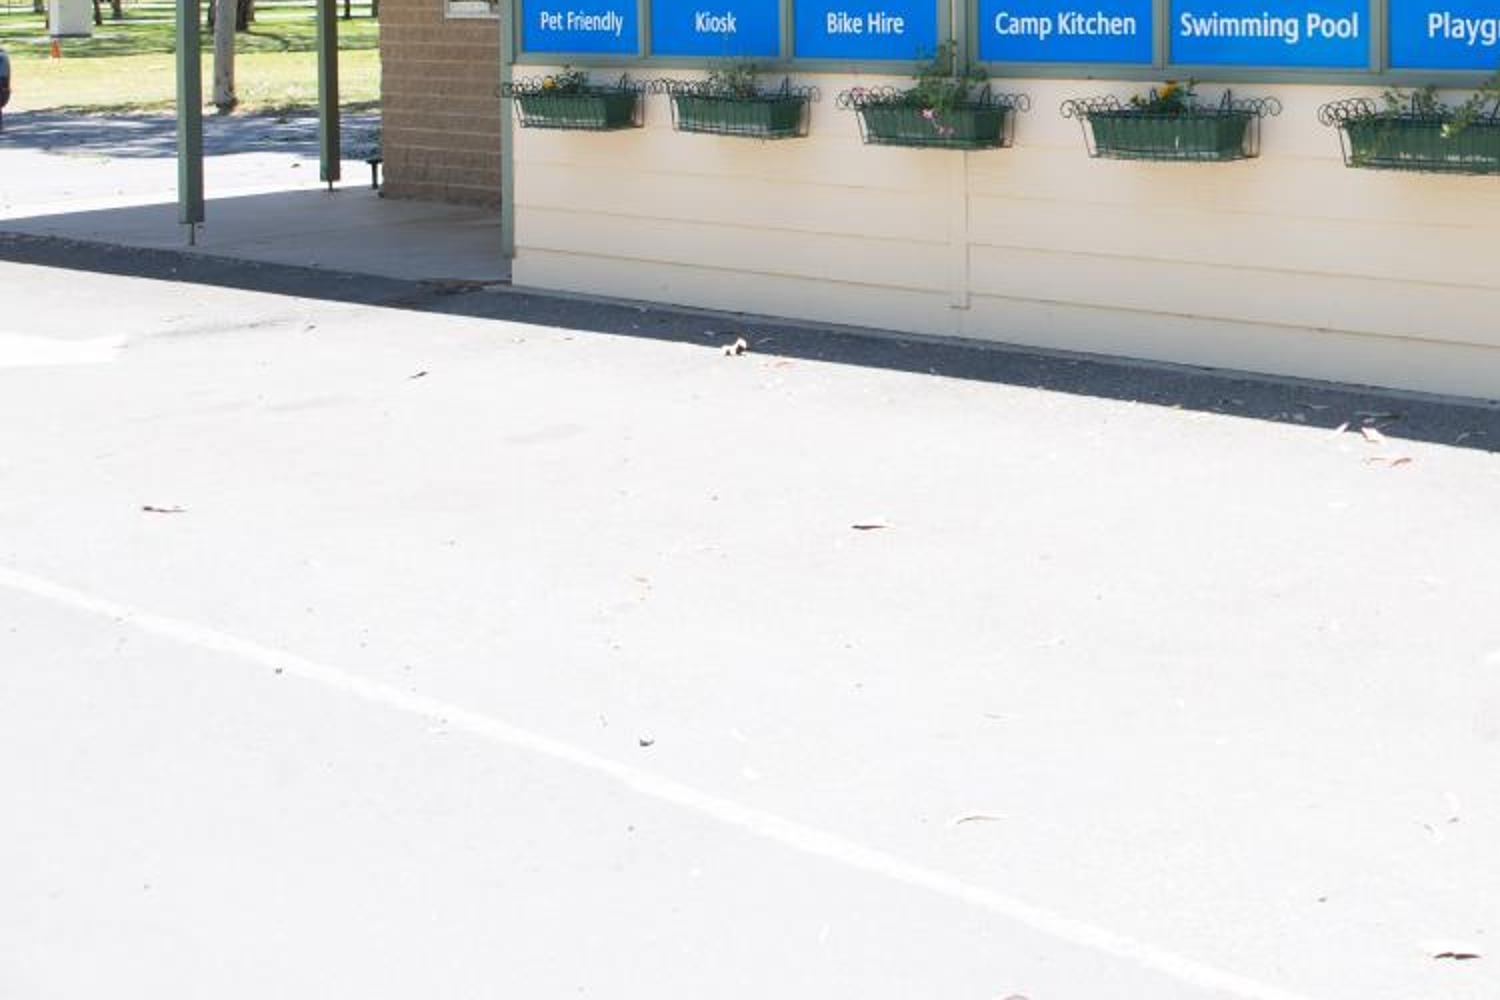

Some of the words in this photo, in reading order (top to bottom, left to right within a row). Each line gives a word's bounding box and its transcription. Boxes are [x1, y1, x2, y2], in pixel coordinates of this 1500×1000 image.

[540, 11, 563, 30] Pet
[567, 11, 624, 37] Friendly
[695, 12, 737, 34] Kiosk
[827, 12, 863, 34] Bike
[867, 12, 904, 34] Hire
[995, 11, 1052, 41] Camp
[1057, 11, 1136, 36] Kitchen
[1180, 12, 1299, 44] Swimming
[1306, 12, 1359, 38] Pool
